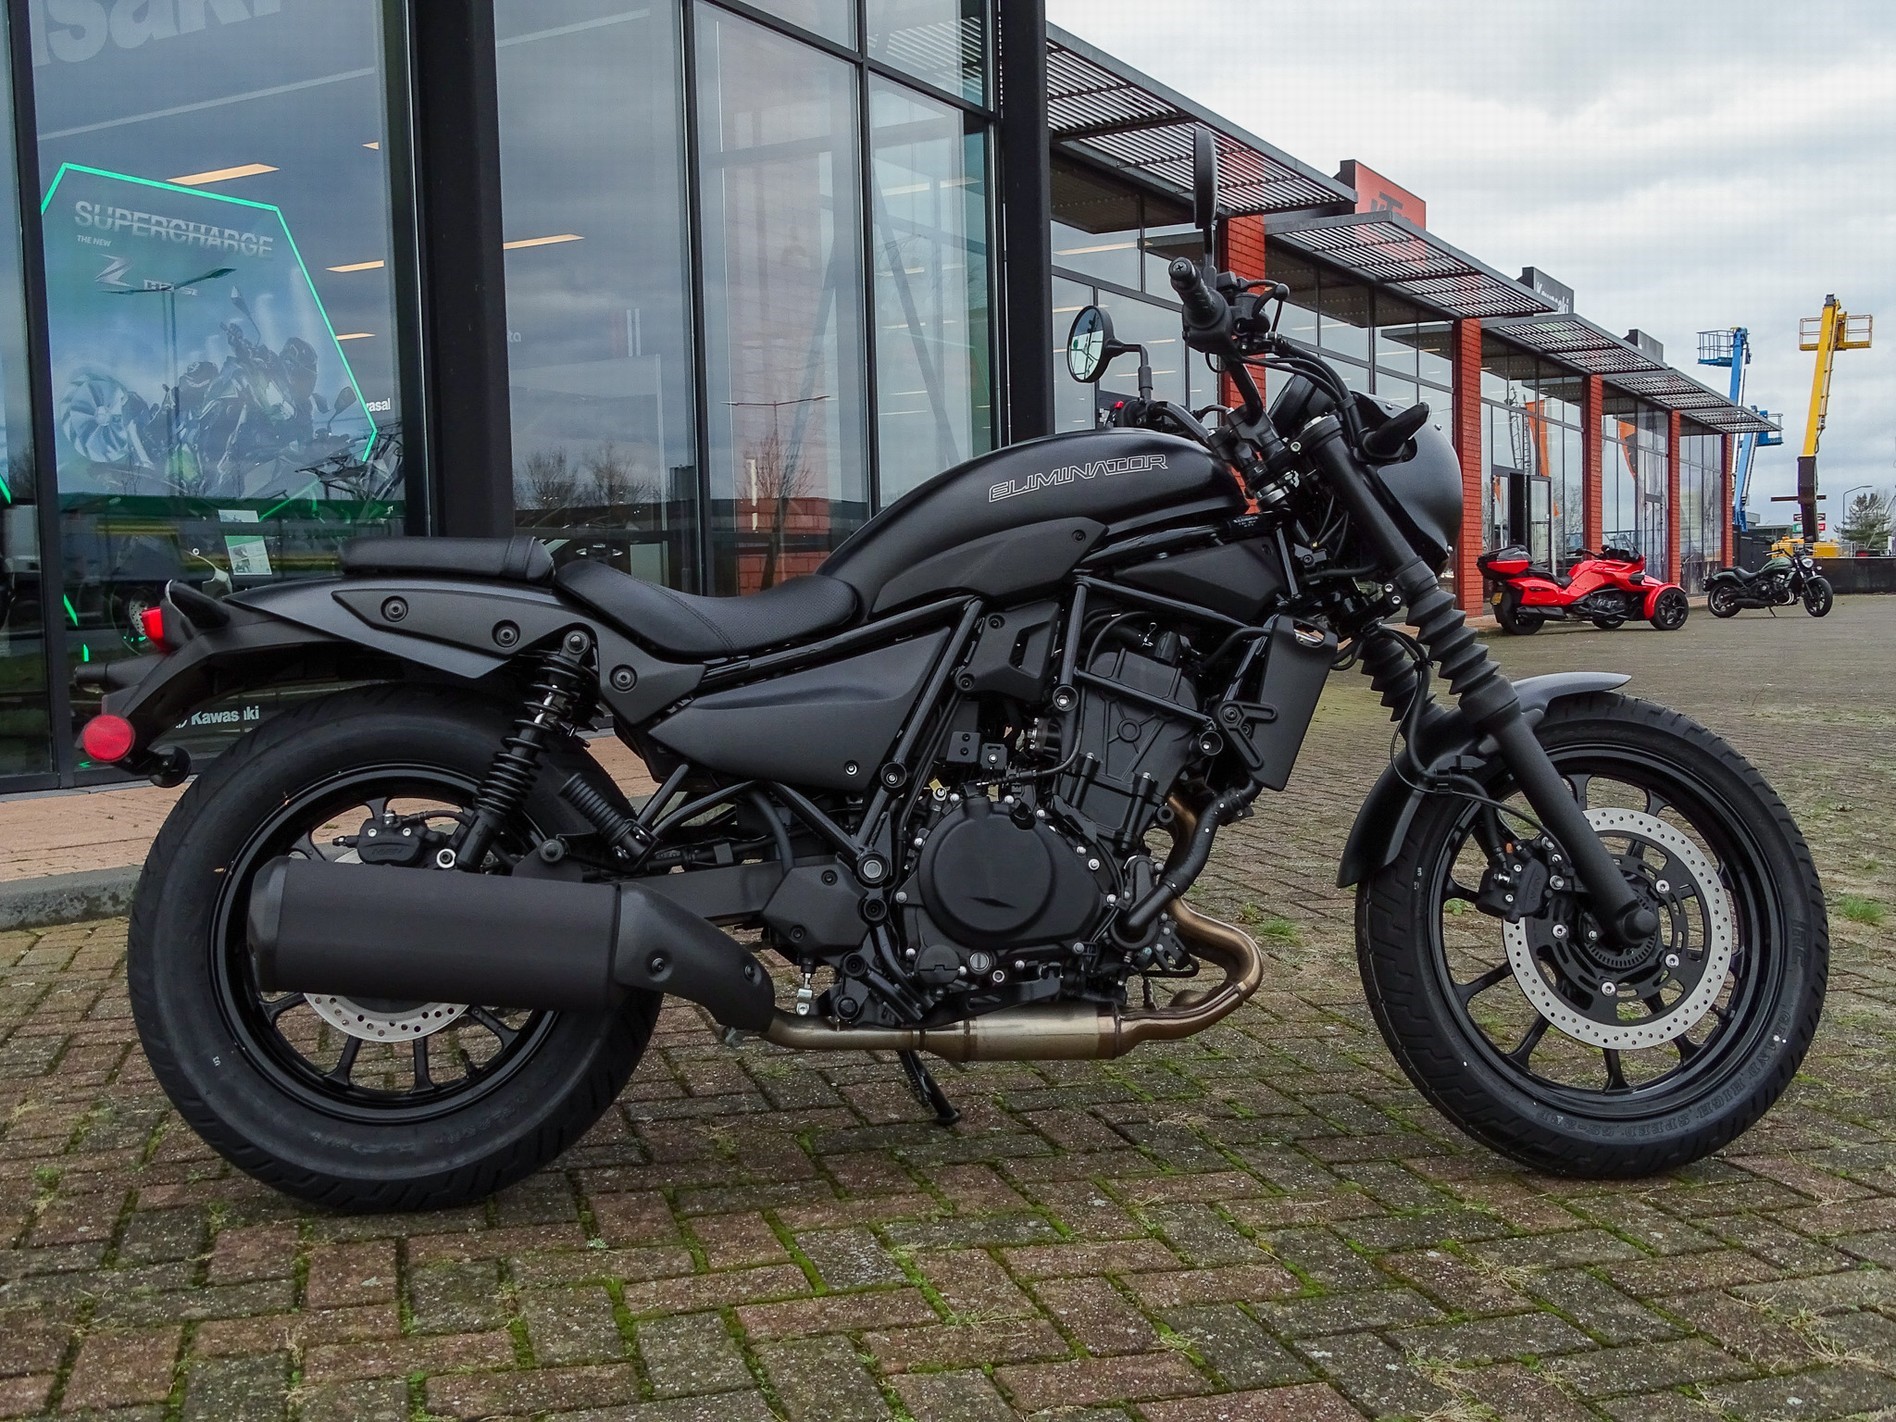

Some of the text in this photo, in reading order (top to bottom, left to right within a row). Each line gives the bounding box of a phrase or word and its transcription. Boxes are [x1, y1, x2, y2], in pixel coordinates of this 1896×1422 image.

[74, 200, 274, 258] SUPERCHARGE
[77, 234, 112, 247] THE NEW
[988, 453, 1169, 504] ELIMINATOR
